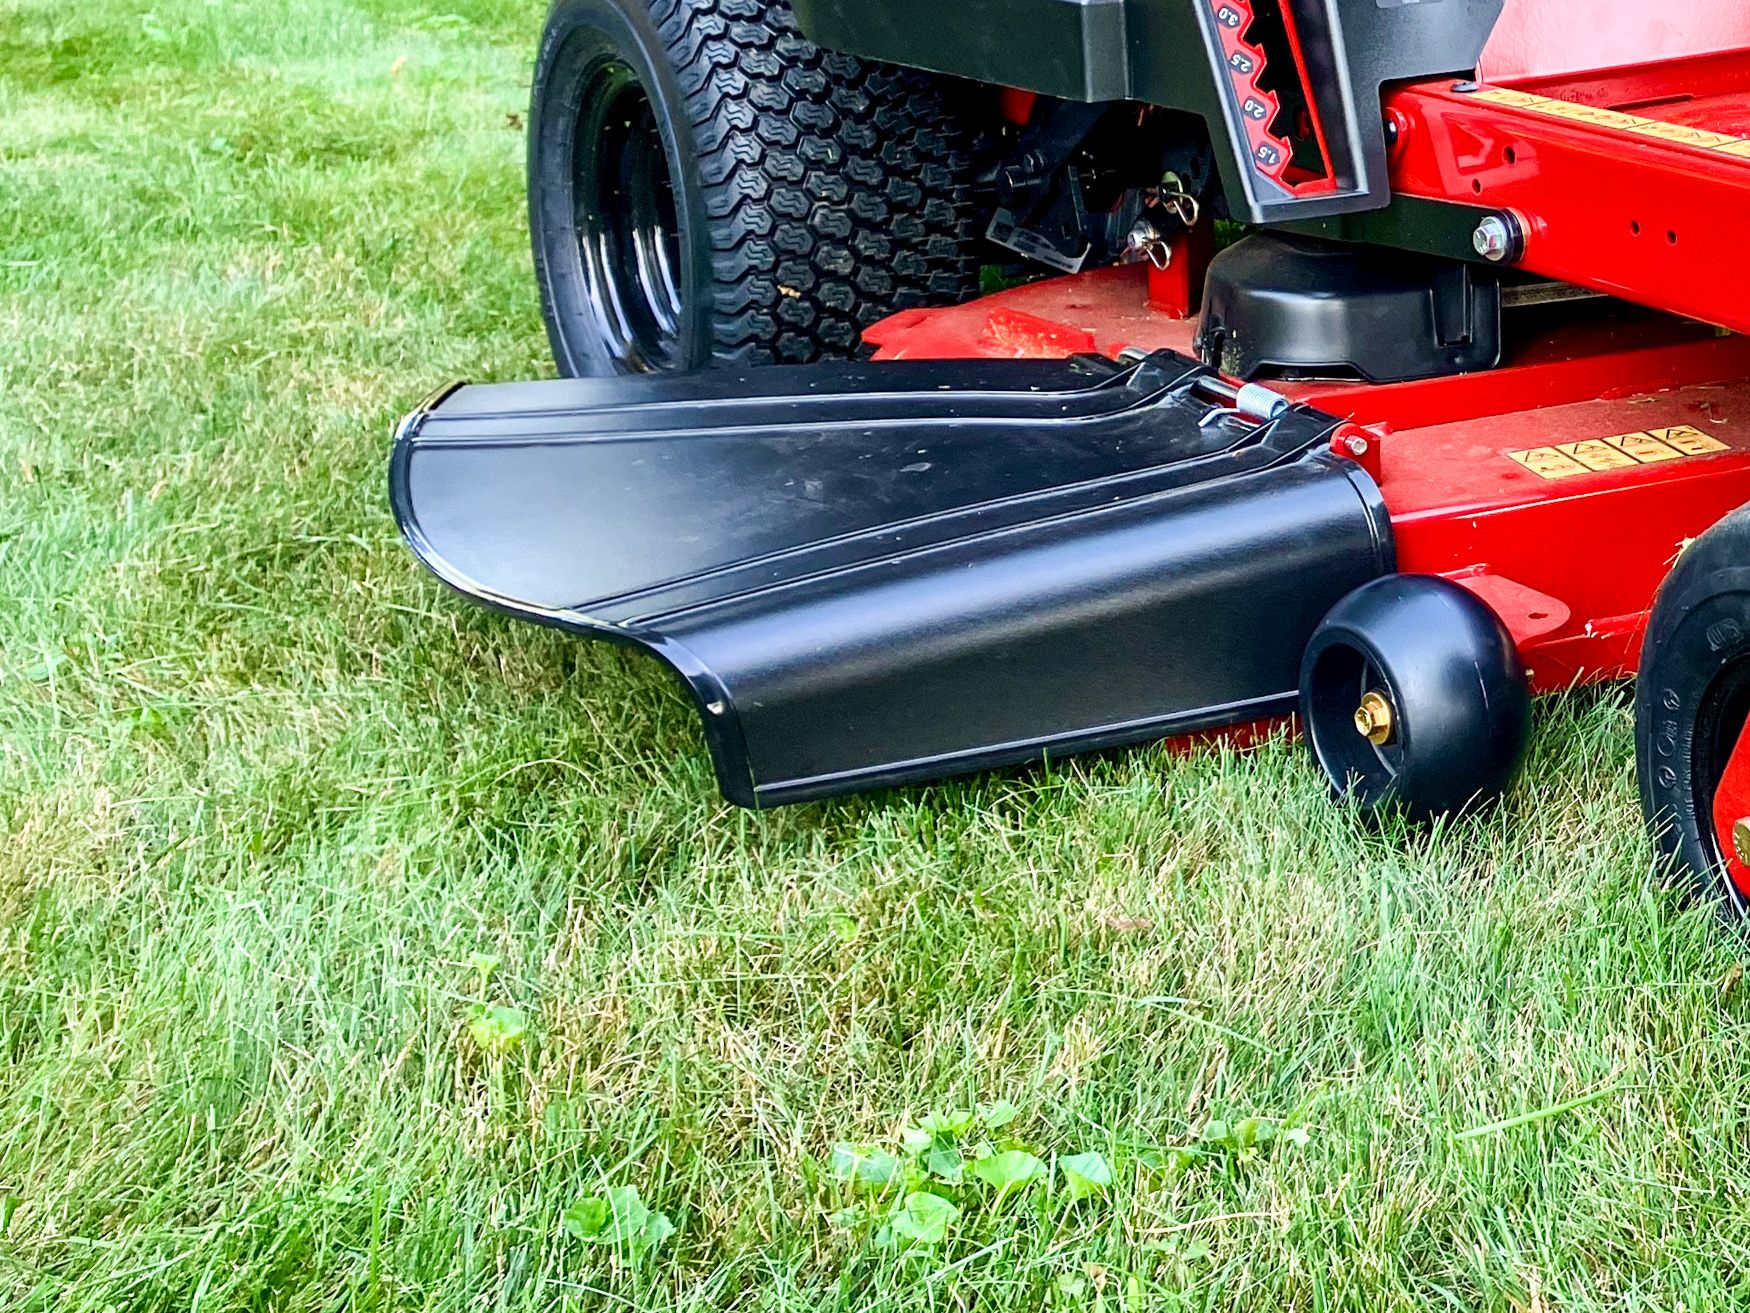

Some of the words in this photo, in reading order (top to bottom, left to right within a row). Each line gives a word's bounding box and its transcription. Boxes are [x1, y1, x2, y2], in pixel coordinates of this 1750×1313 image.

[1218, 7, 1239, 26] 3.0
[1230, 54, 1252, 73] 2.5
[1244, 99, 1265, 118] 2.0
[1258, 146, 1276, 164] 1.5
